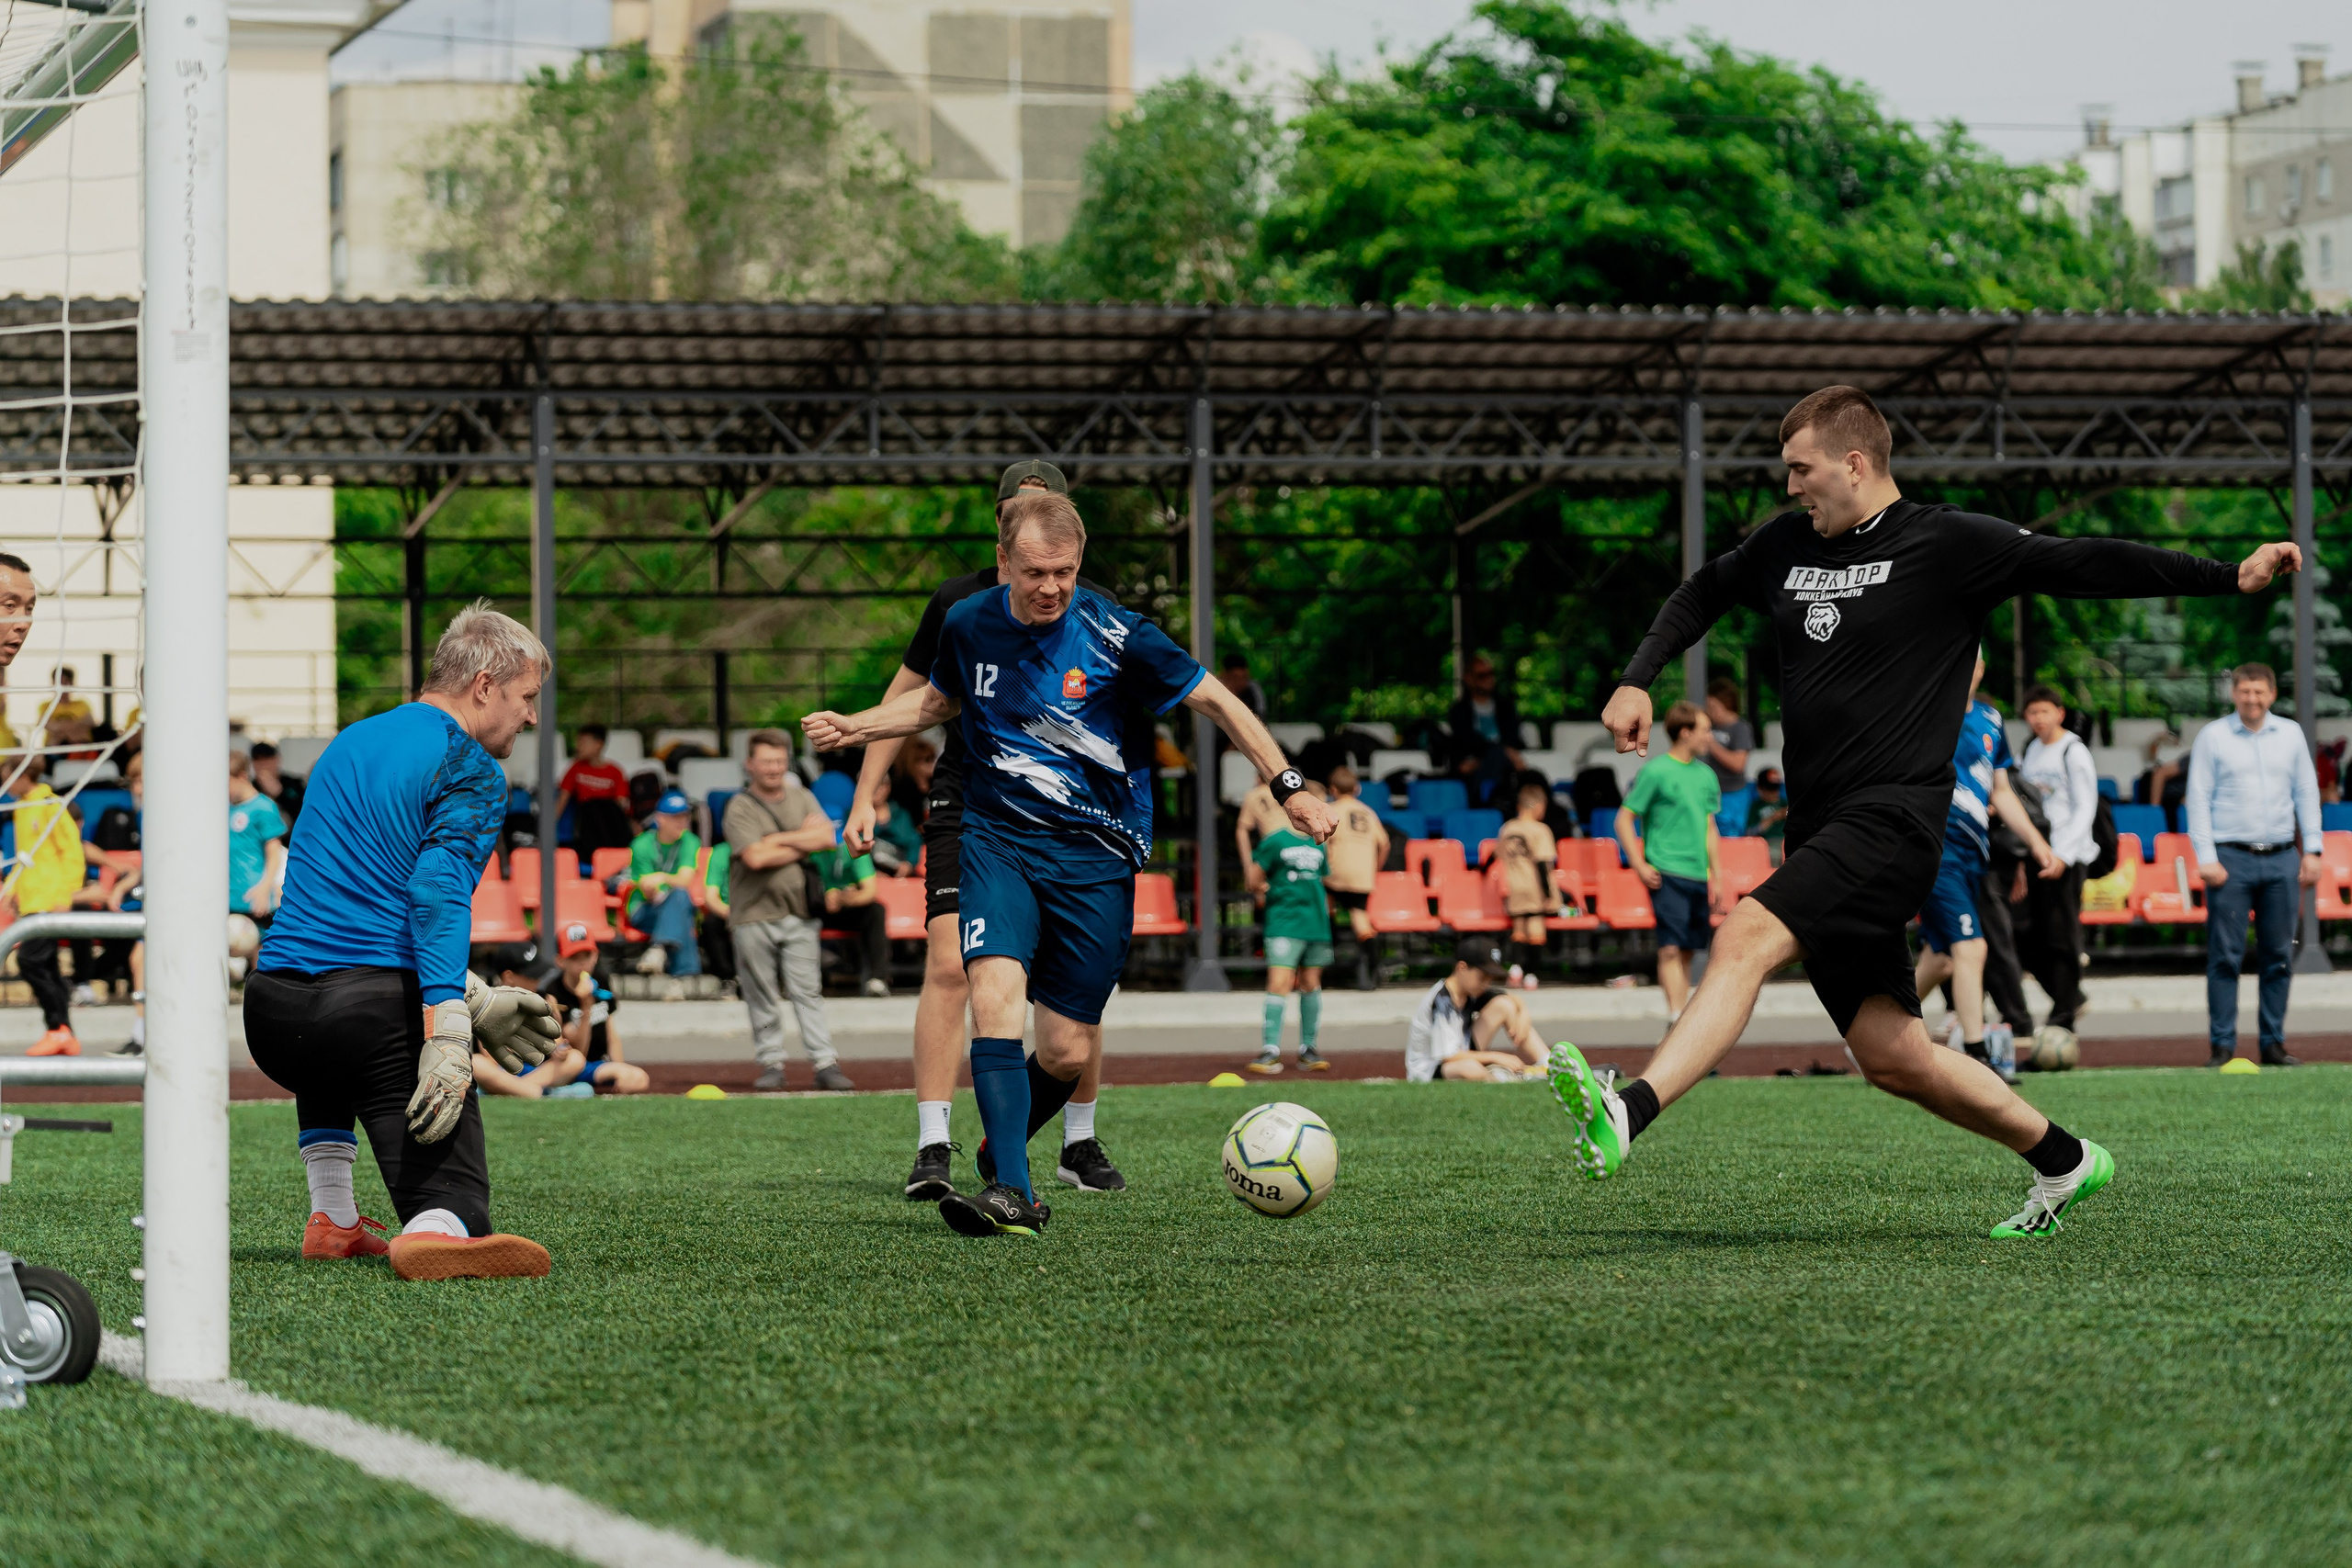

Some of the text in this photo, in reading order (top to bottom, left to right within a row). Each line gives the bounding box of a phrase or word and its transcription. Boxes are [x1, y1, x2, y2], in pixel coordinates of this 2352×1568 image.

[1792, 565, 1882, 589] ТРАКТОР
[1840, 588, 1864, 599] КЛУБ
[975, 662, 999, 698] 12
[964, 917, 986, 954] 12
